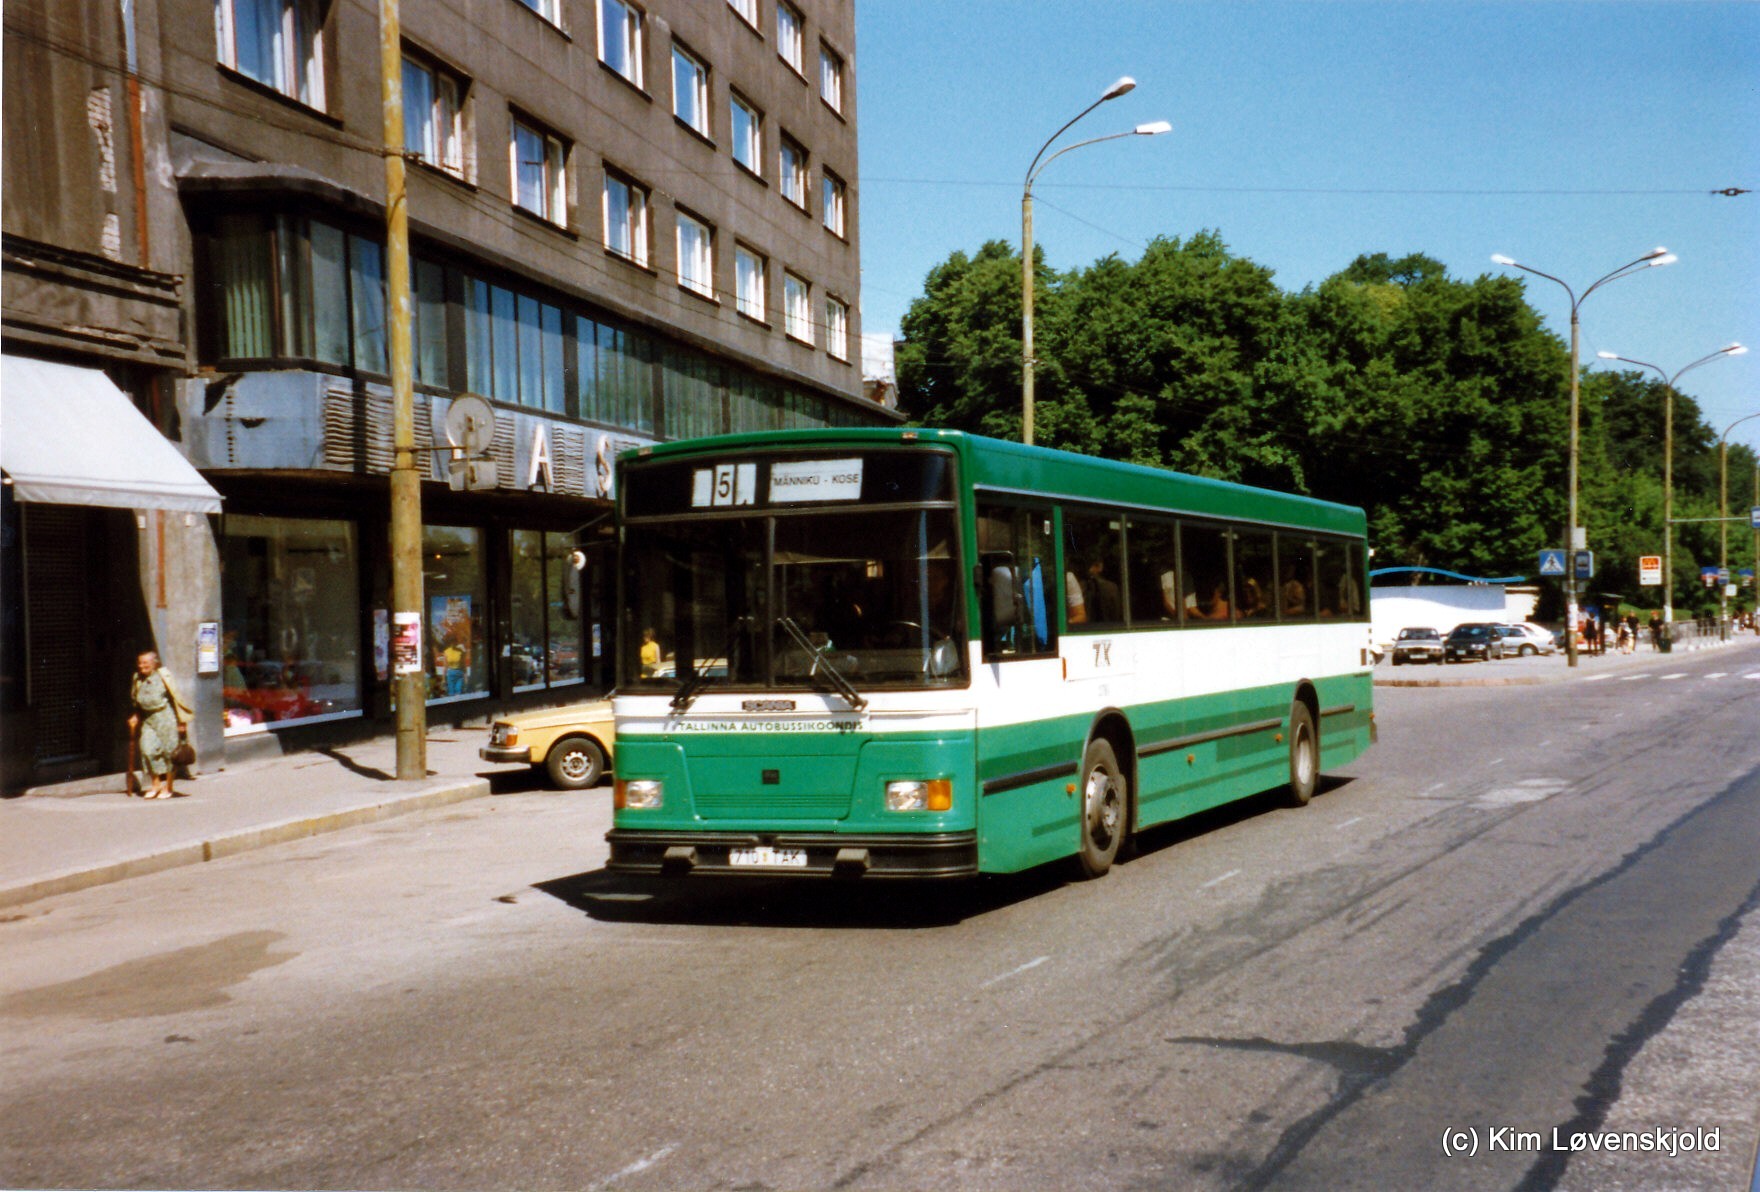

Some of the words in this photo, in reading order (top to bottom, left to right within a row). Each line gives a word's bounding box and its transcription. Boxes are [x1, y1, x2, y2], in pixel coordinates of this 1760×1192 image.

[832, 473, 859, 484] KOSE
[718, 472, 730, 498] 5
[679, 721, 737, 732] TALLINNA
